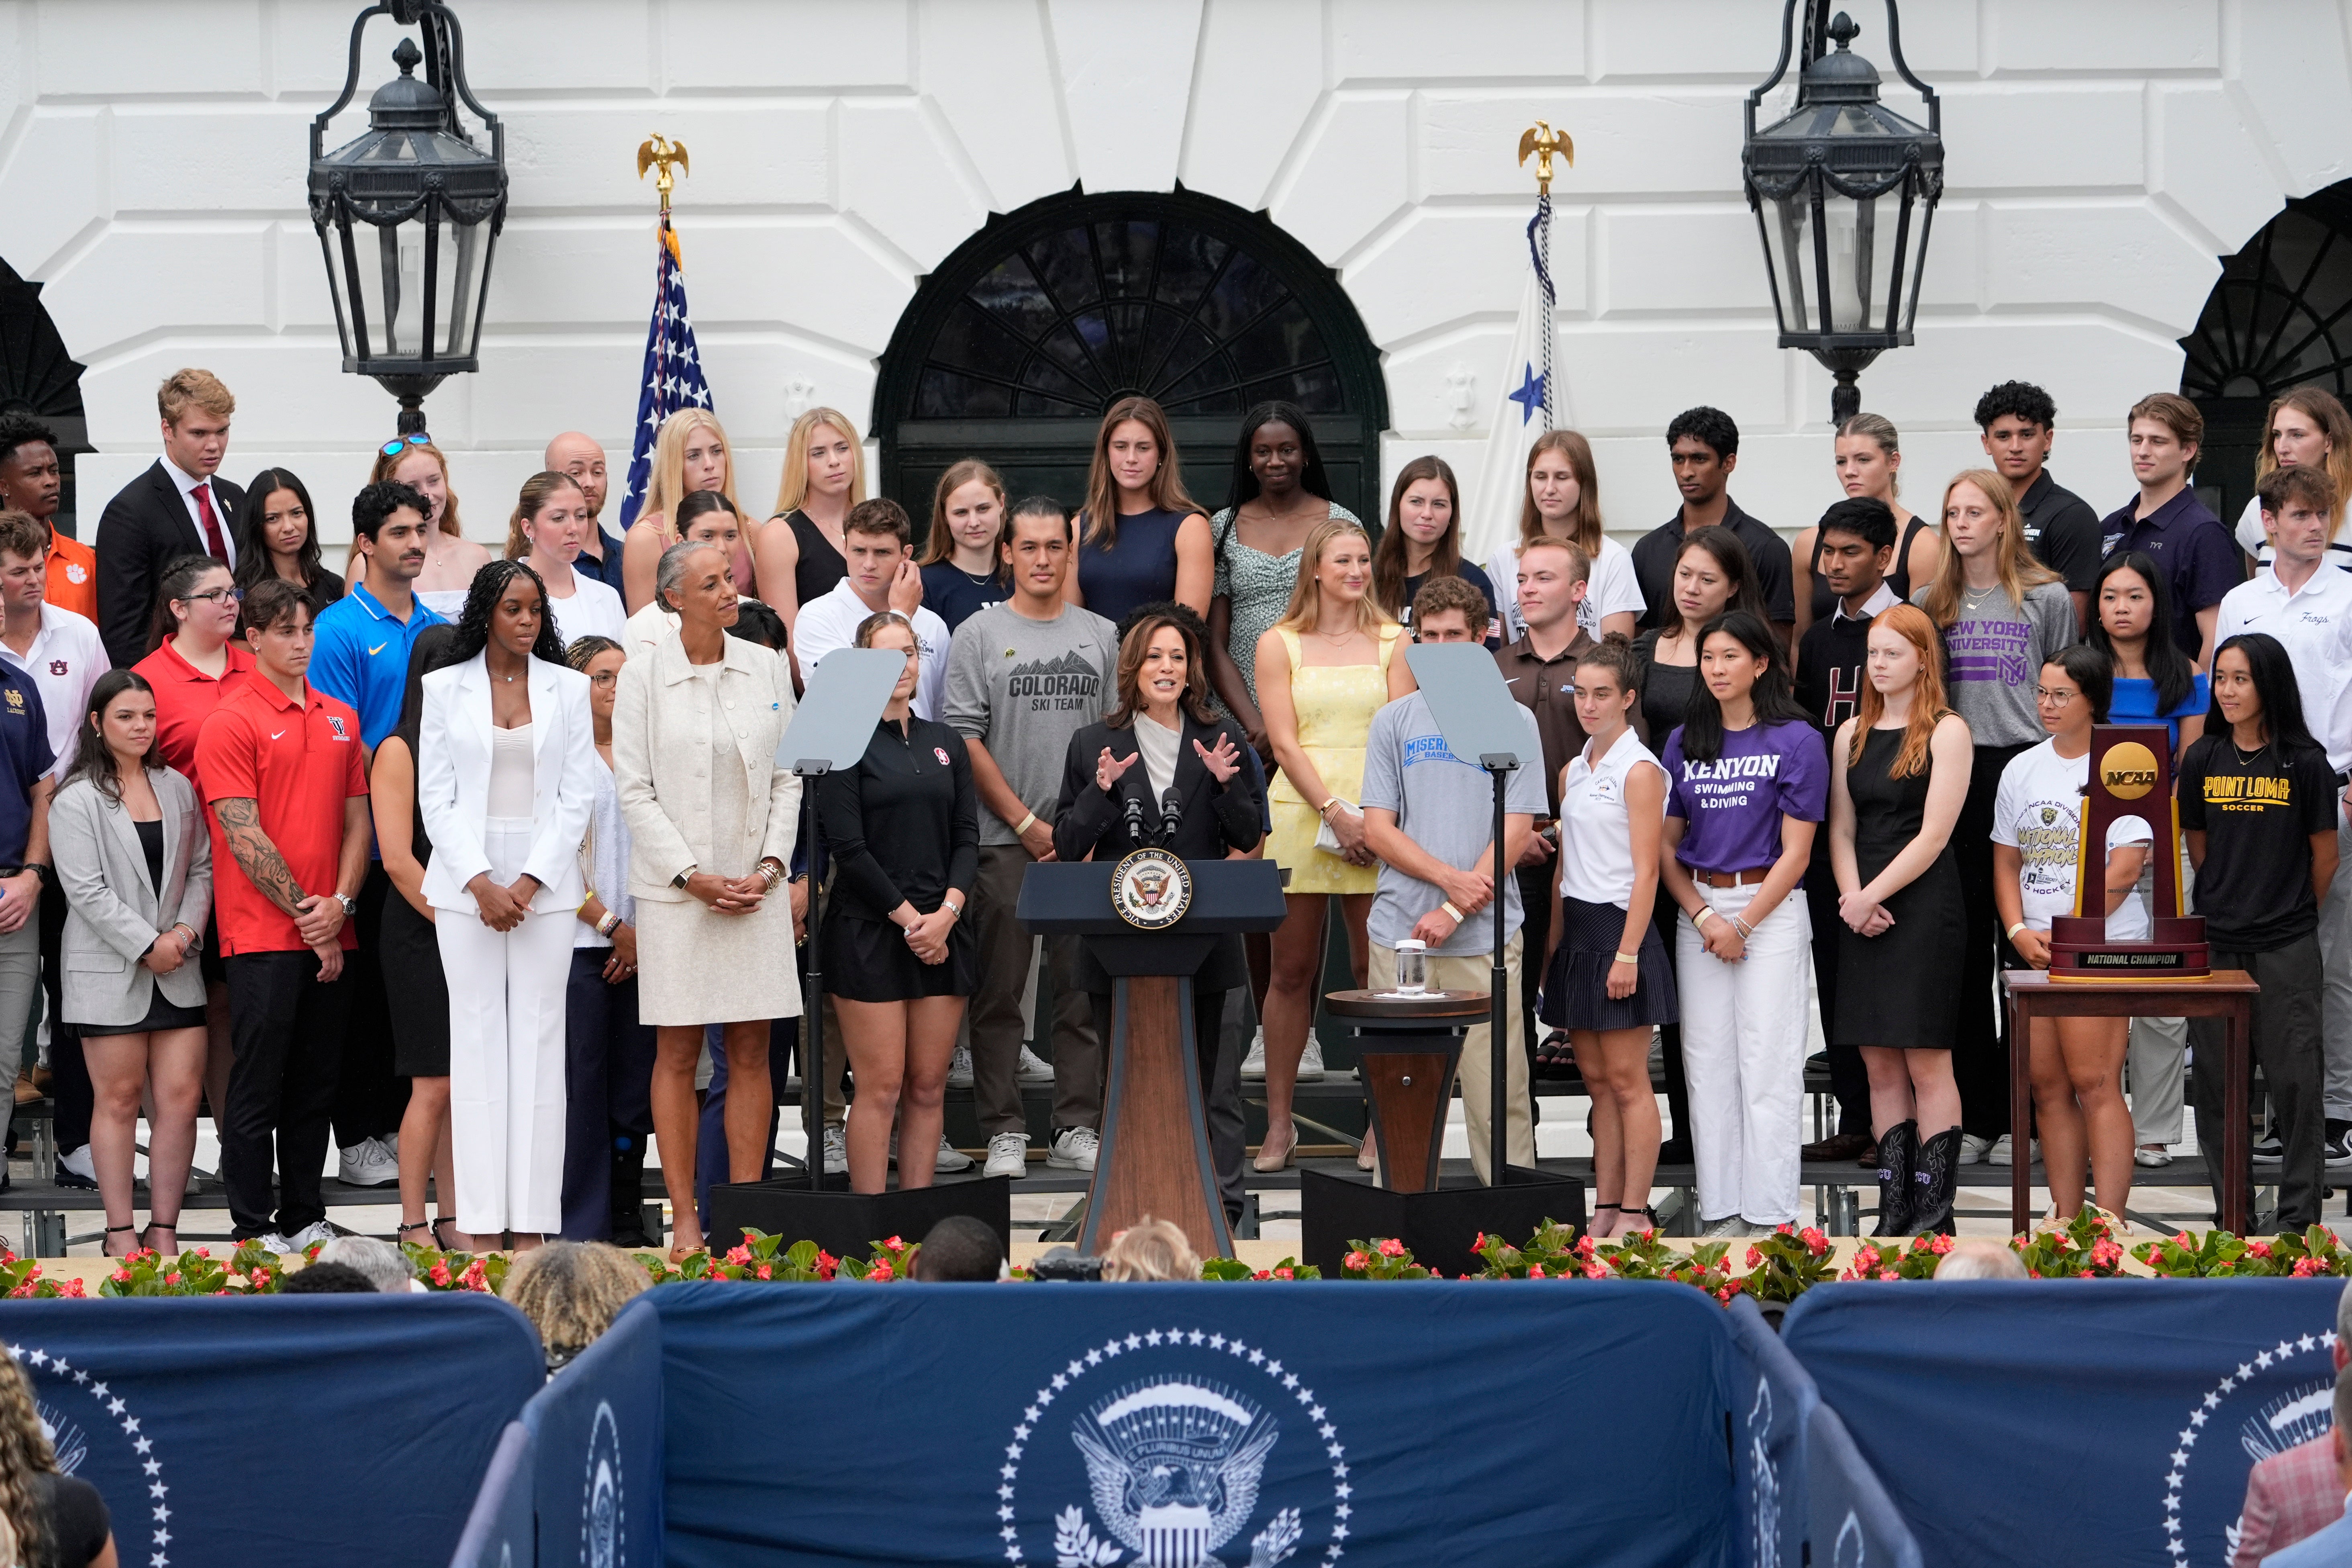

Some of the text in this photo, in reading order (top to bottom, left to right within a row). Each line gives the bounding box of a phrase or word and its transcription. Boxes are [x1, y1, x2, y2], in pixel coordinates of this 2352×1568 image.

[2299, 612, 2329, 625] Frogs
[1981, 621, 2031, 638] YORK
[1948, 637, 2027, 653] NIVERSITY
[1009, 675, 1100, 697] COLORADO
[1032, 698, 1083, 711] SKI TEAM
[1825, 665, 1861, 727] H
[7, 707, 26, 715] LACROSSE
[1683, 755, 1780, 782] KENYON
[2105, 770, 2156, 786] NCAA
[1694, 781, 1755, 794] SWIMMING
[2203, 776, 2291, 800] POINT LOMA
[2029, 800, 2052, 809] NCAA
[2017, 826, 2079, 849] NATIONAL
[1167, 855, 1190, 888] UNITED
[1113, 857, 1134, 904] PRESIDENT
[2033, 878, 2070, 894] HOCKEY
[1121, 906, 1139, 925] VICE
[1166, 892, 1189, 923] STATES
[2087, 955, 2176, 964] NATIONAL CHAMPION
[1137, 1442, 1190, 1456] PLURIBUS
[1191, 1447, 1225, 1460] UNUM
